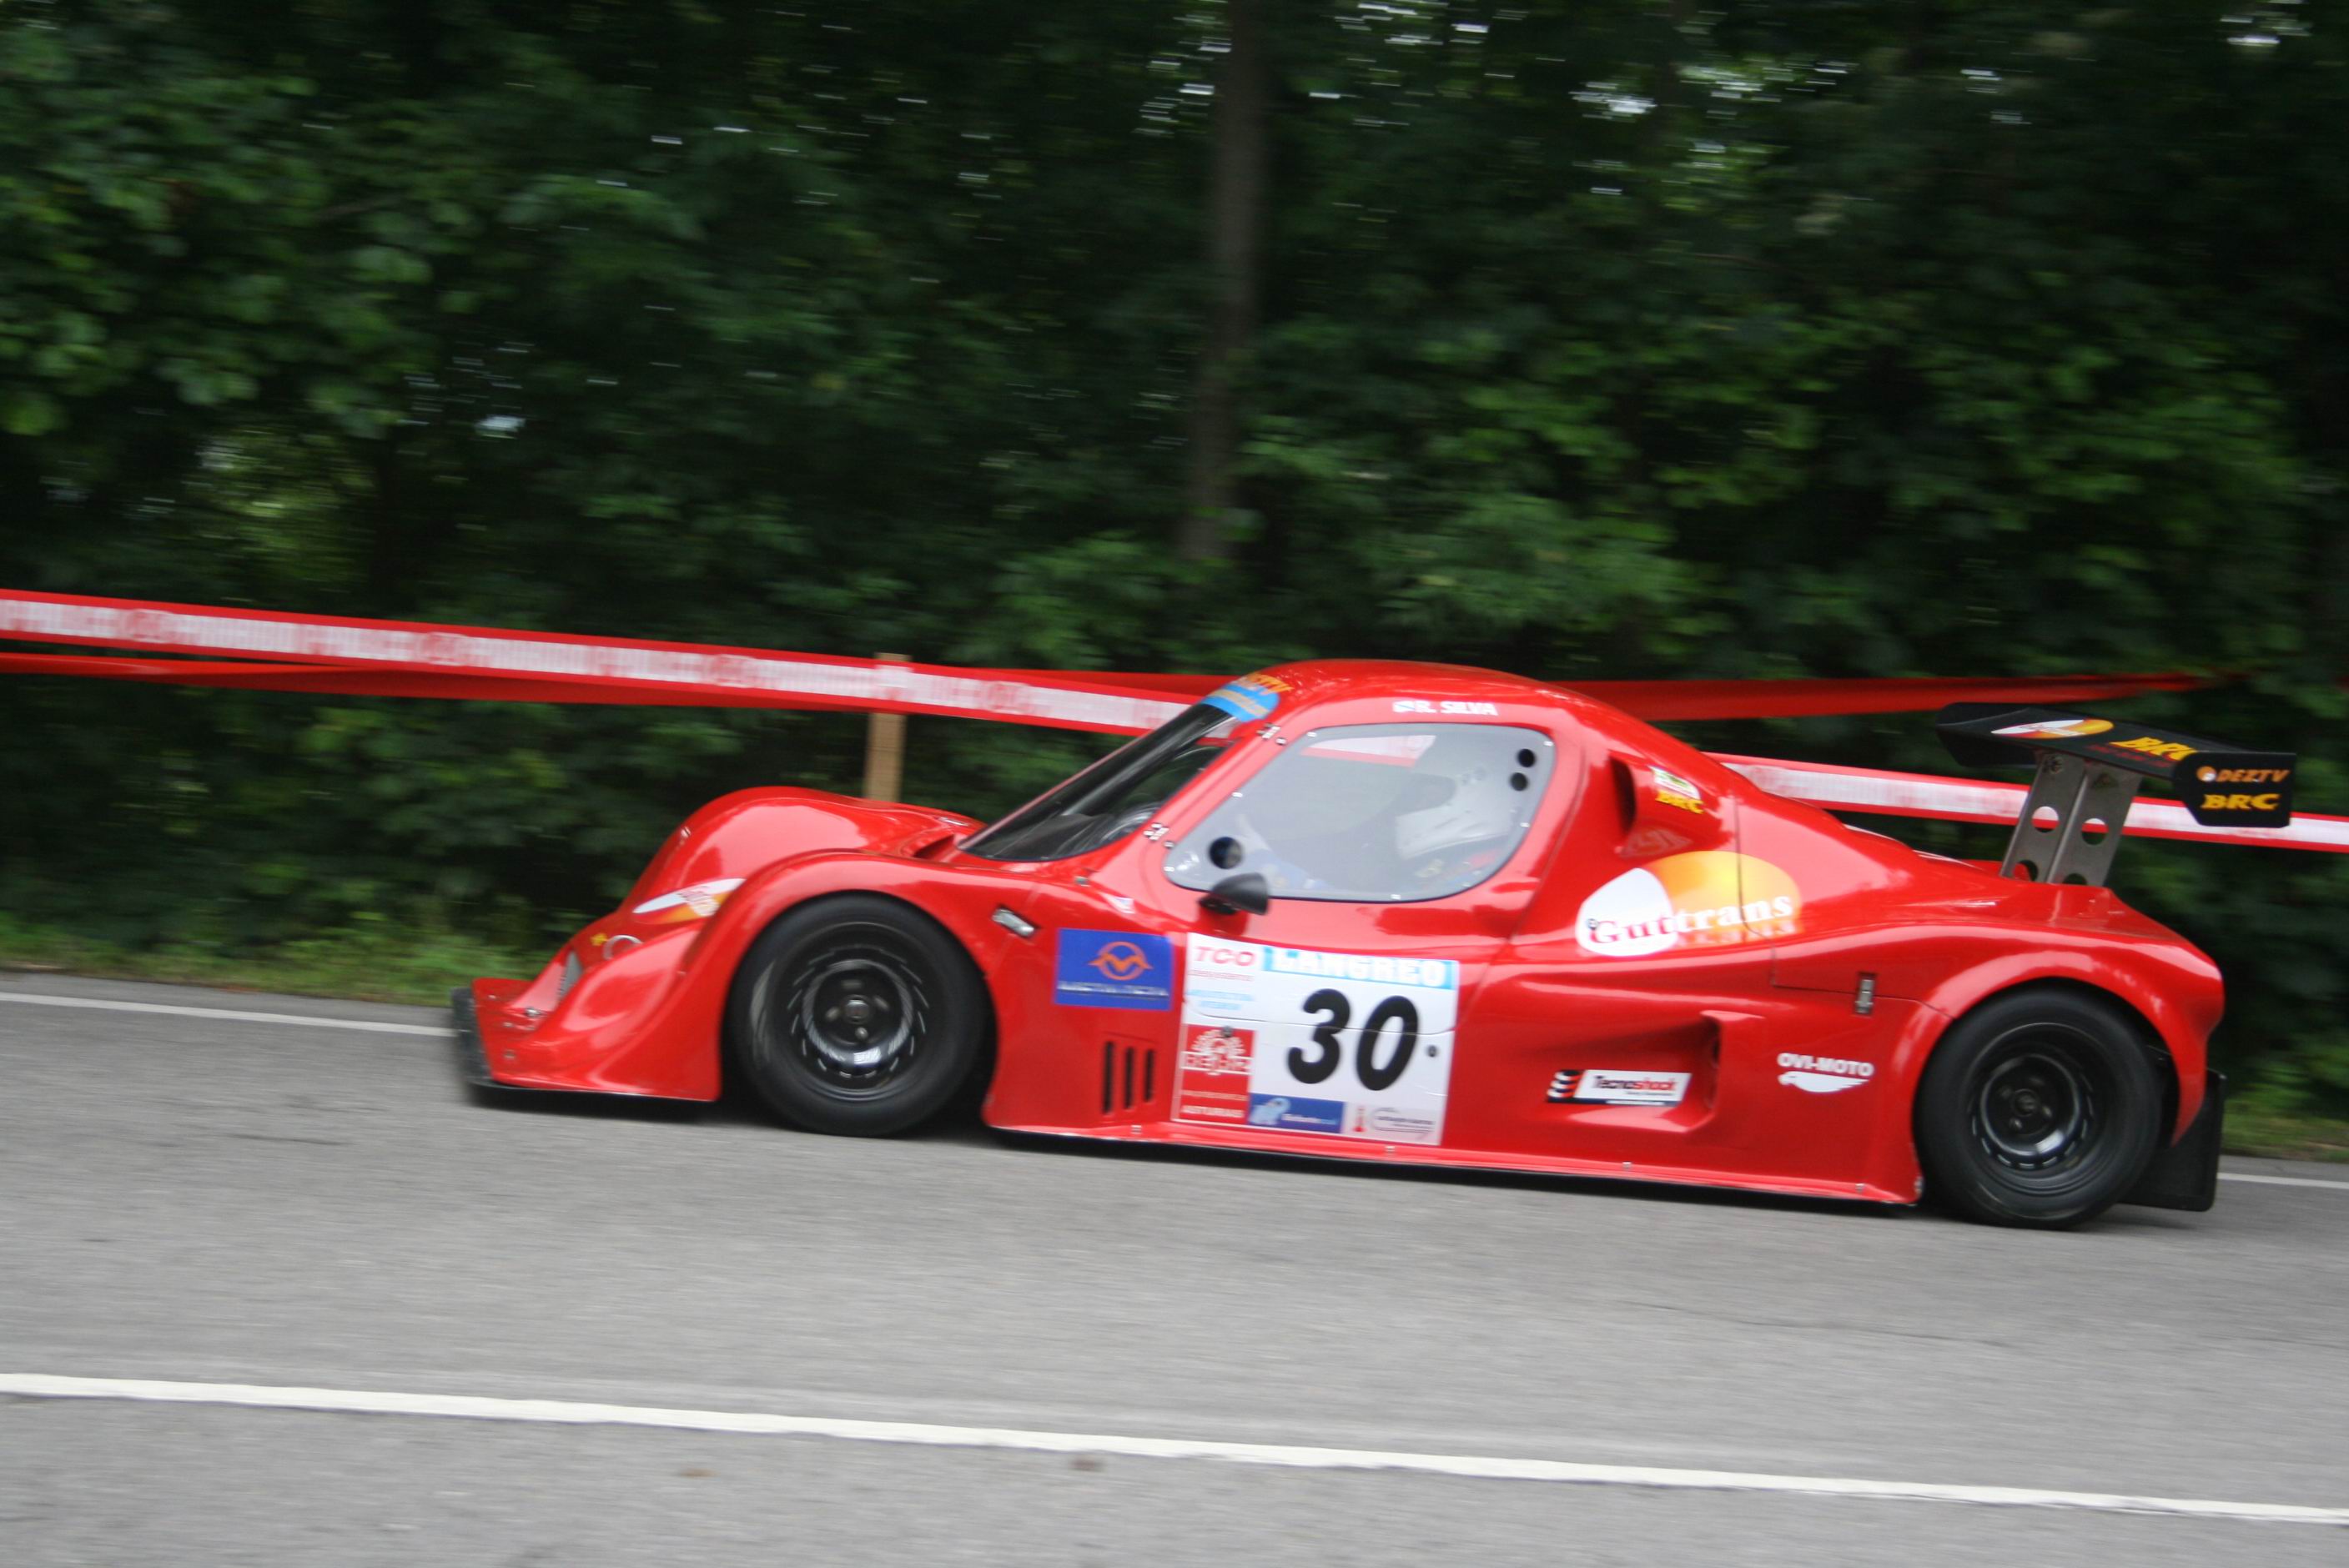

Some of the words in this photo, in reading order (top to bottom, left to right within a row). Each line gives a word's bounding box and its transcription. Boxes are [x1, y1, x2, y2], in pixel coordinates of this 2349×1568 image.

[1441, 701, 1498, 716] SILVA
[2216, 769, 2291, 782] DEZTV
[1656, 789, 1704, 814] BRC
[2201, 793, 2281, 810] BRC
[1194, 946, 1255, 967] TCO
[1273, 949, 1447, 988] LANGREO
[1288, 988, 1418, 1091] 30
[1777, 1053, 1874, 1077] OVI-MOTO
